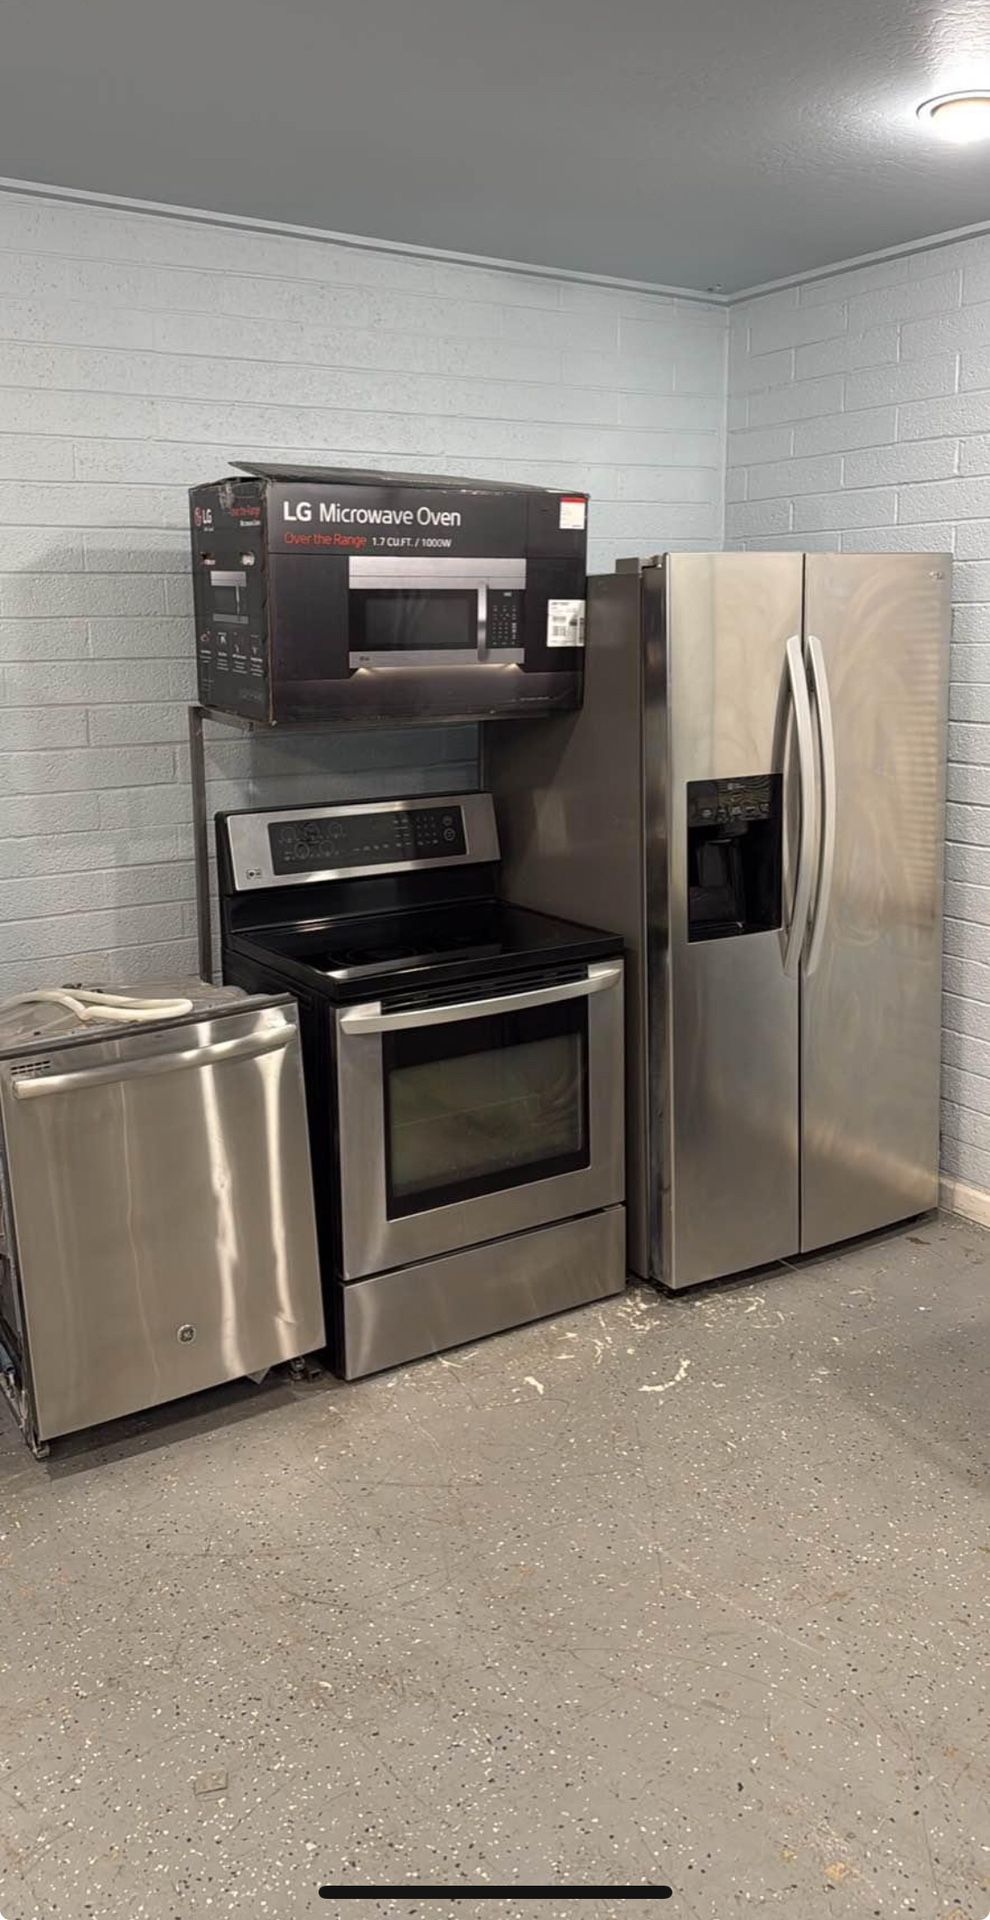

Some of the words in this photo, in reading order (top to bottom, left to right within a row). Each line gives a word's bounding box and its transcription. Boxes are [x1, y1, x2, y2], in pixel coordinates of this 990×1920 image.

[203, 508, 213, 524] LG
[283, 500, 312, 522] LG
[319, 502, 413, 526] Microwave
[416, 506, 461, 527] Oven
[284, 531, 313, 545] Over
[313, 533, 331, 545] the
[333, 533, 367, 549] Range
[372, 537, 385, 546] 1.7
[421, 538, 452, 548] 1000W
